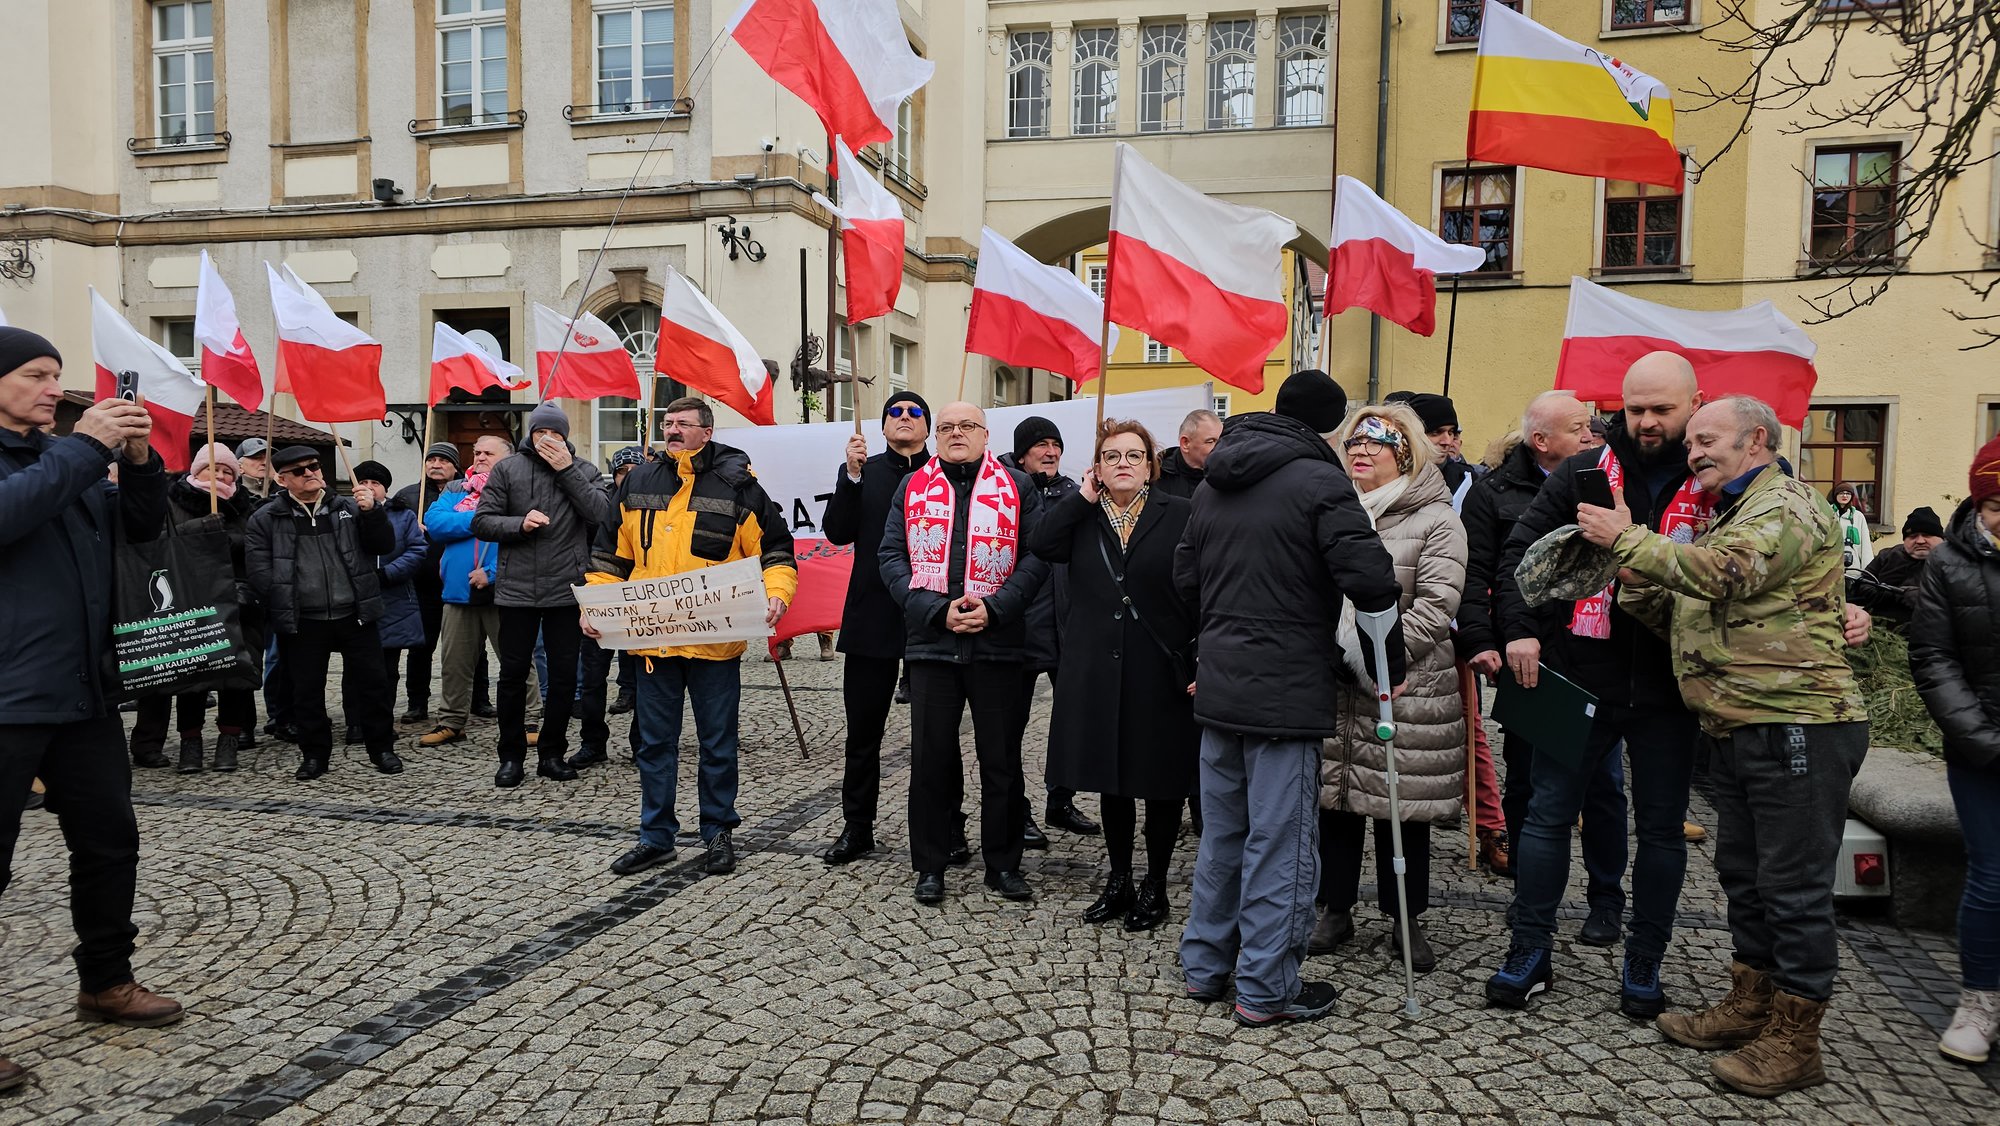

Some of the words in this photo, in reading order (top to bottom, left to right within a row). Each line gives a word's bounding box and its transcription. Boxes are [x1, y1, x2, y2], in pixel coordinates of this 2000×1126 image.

[1678, 502, 1718, 517] TYLK
[622, 577, 694, 602] EUROPO
[586, 603, 639, 618] POWSTAŃ
[649, 602, 660, 614] Z
[675, 590, 722, 611] KOLAN
[687, 610, 697, 620] Z
[143, 627, 158, 637] AM
[159, 619, 197, 634] BAHNHOF
[119, 638, 230, 668] Pinguin-Apotheke
[153, 663, 165, 672] IM
[165, 654, 208, 669] KAUFLAND
[1787, 726, 1808, 776] PERKER
